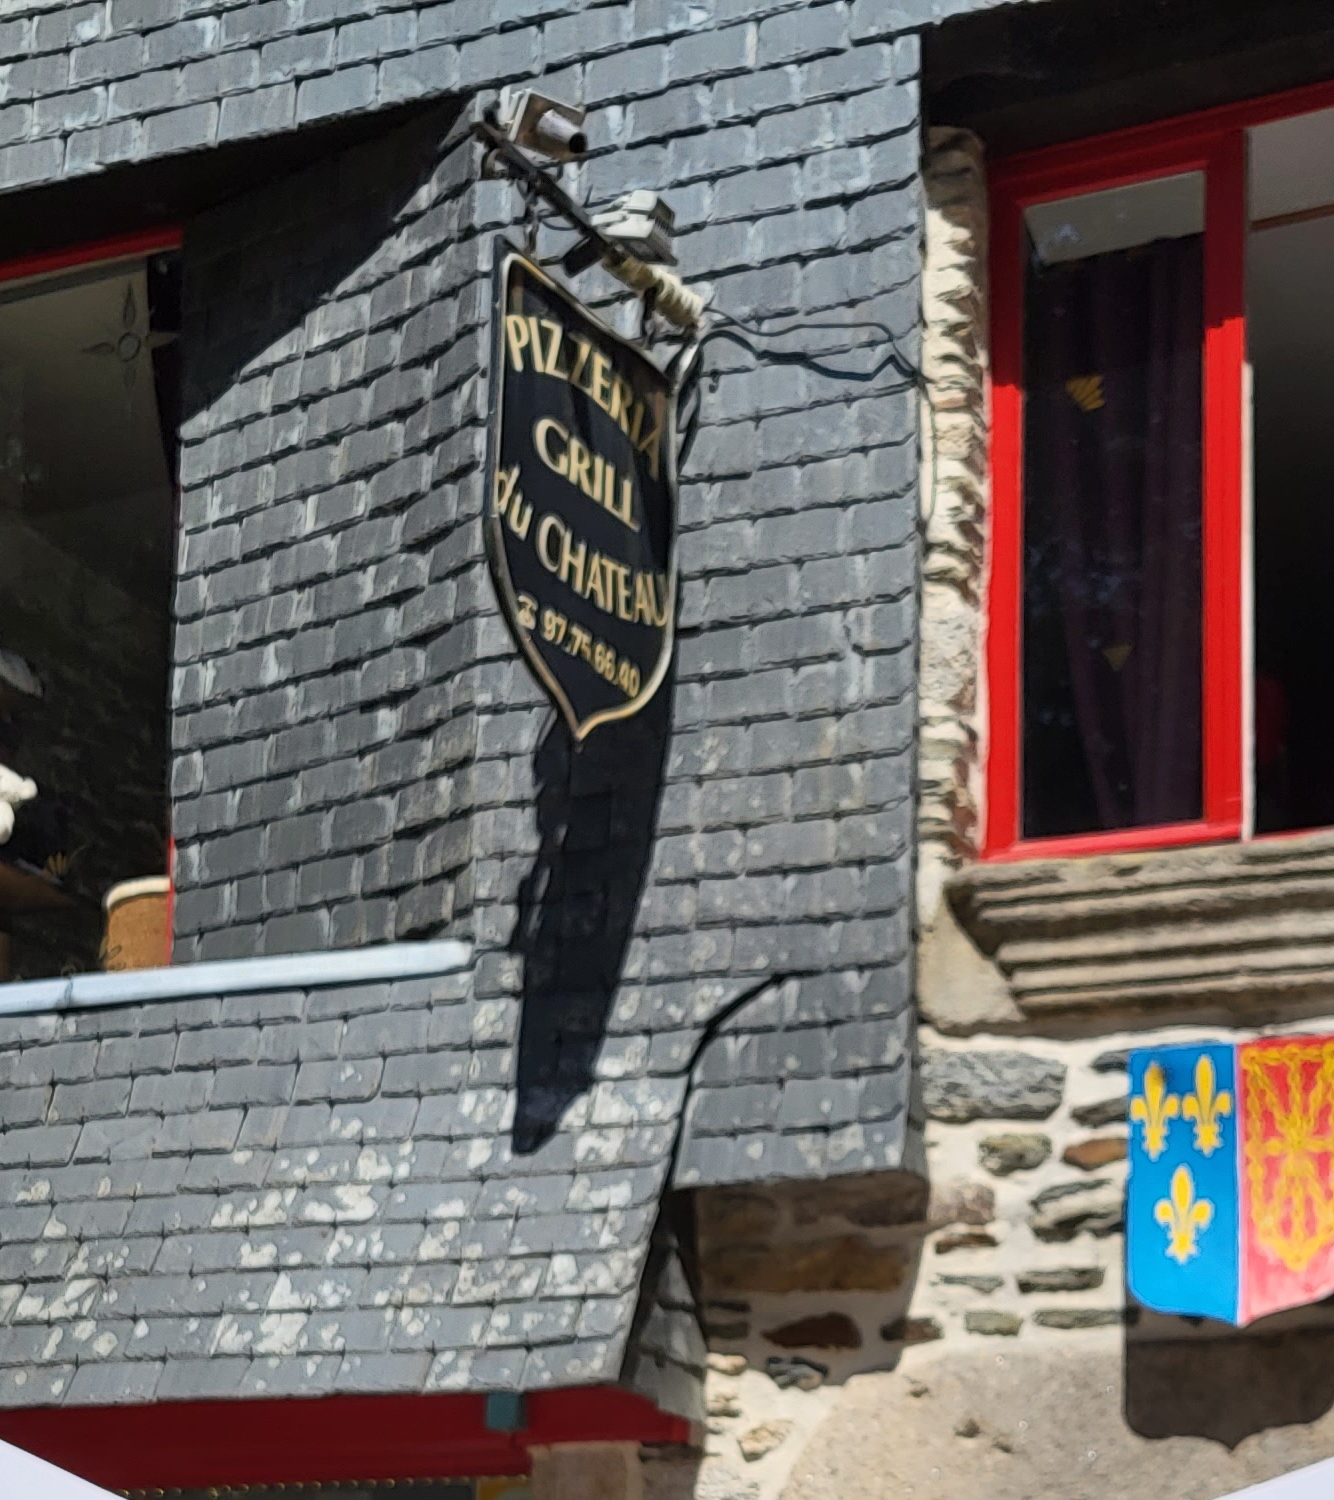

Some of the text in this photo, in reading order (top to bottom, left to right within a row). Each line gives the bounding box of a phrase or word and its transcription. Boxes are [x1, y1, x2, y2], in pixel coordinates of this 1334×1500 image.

[506, 315, 665, 481] PIZZERIA
[535, 418, 640, 531] GRILL
[494, 463, 668, 627] du CHATEAU
